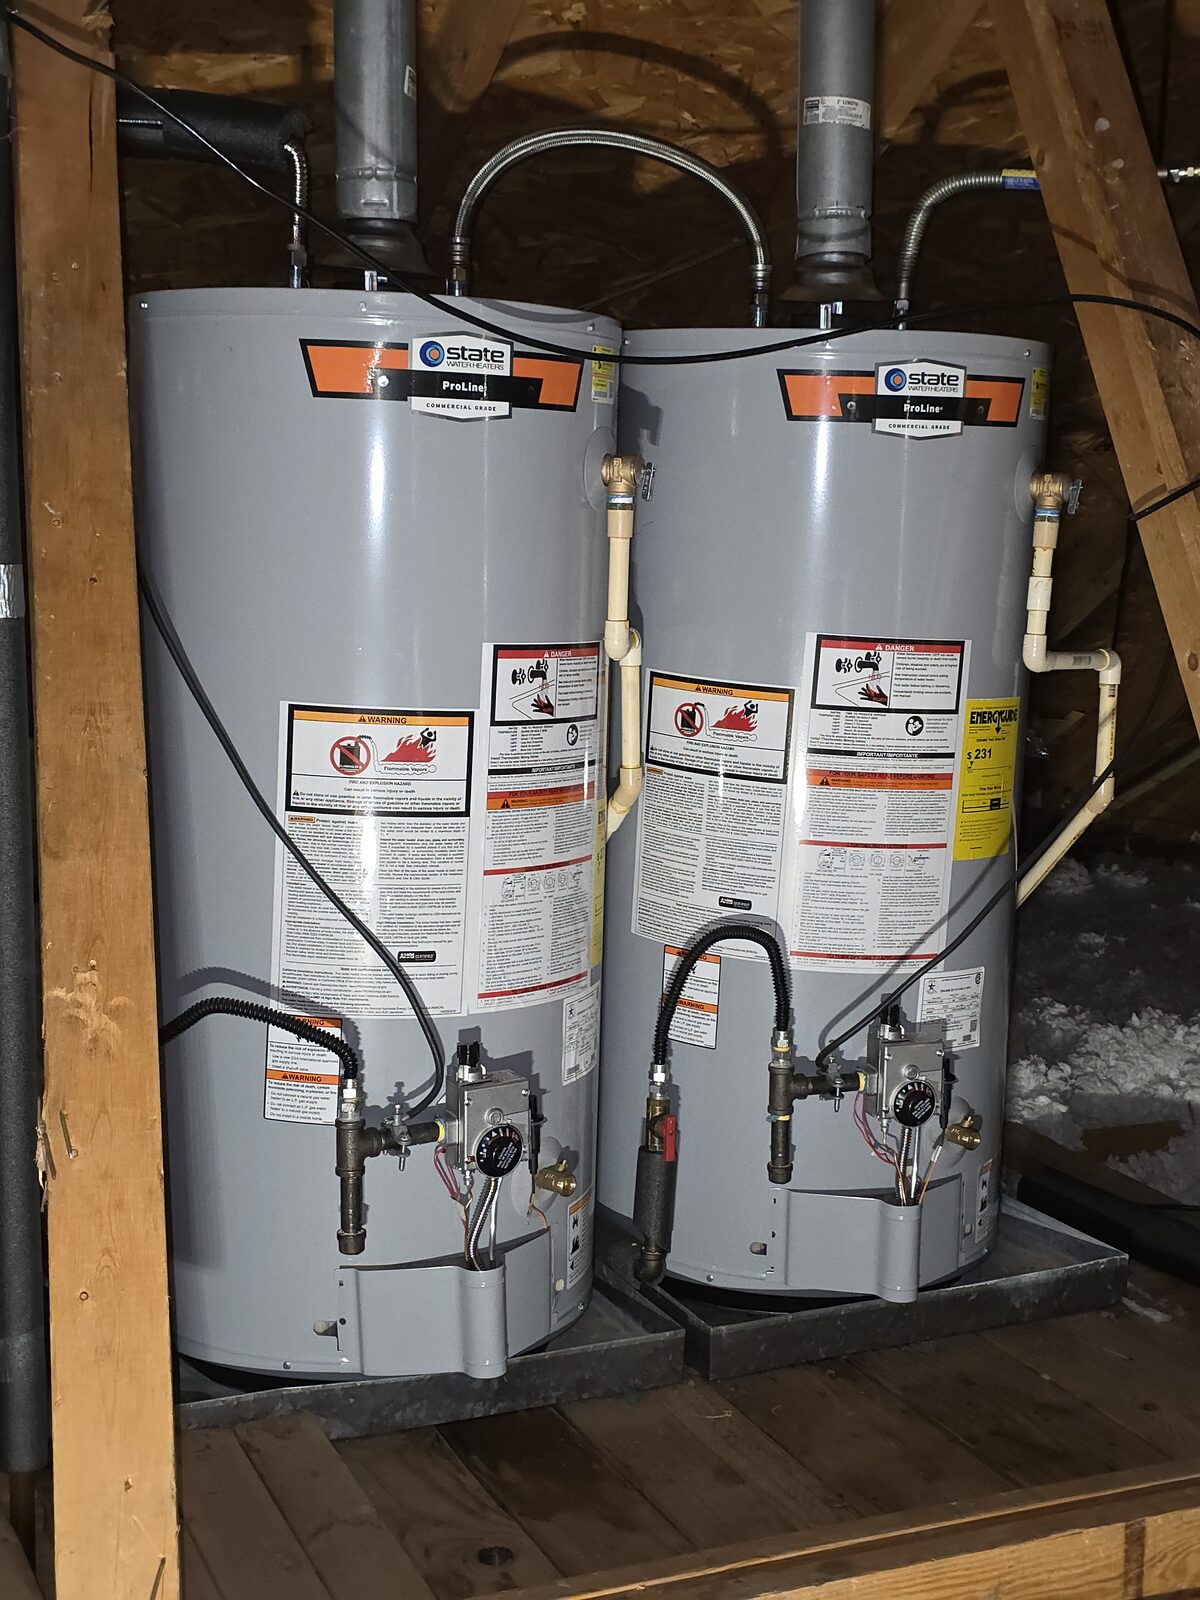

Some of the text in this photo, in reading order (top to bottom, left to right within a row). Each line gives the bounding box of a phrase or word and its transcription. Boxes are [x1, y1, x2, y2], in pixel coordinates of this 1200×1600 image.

[447, 346, 504, 364] state
[472, 362, 504, 370] HEATERS
[908, 372, 959, 386] state
[702, 686, 733, 695] WARNING
[975, 748, 992, 759] 231
[289, 1074, 322, 1082] WARNING
